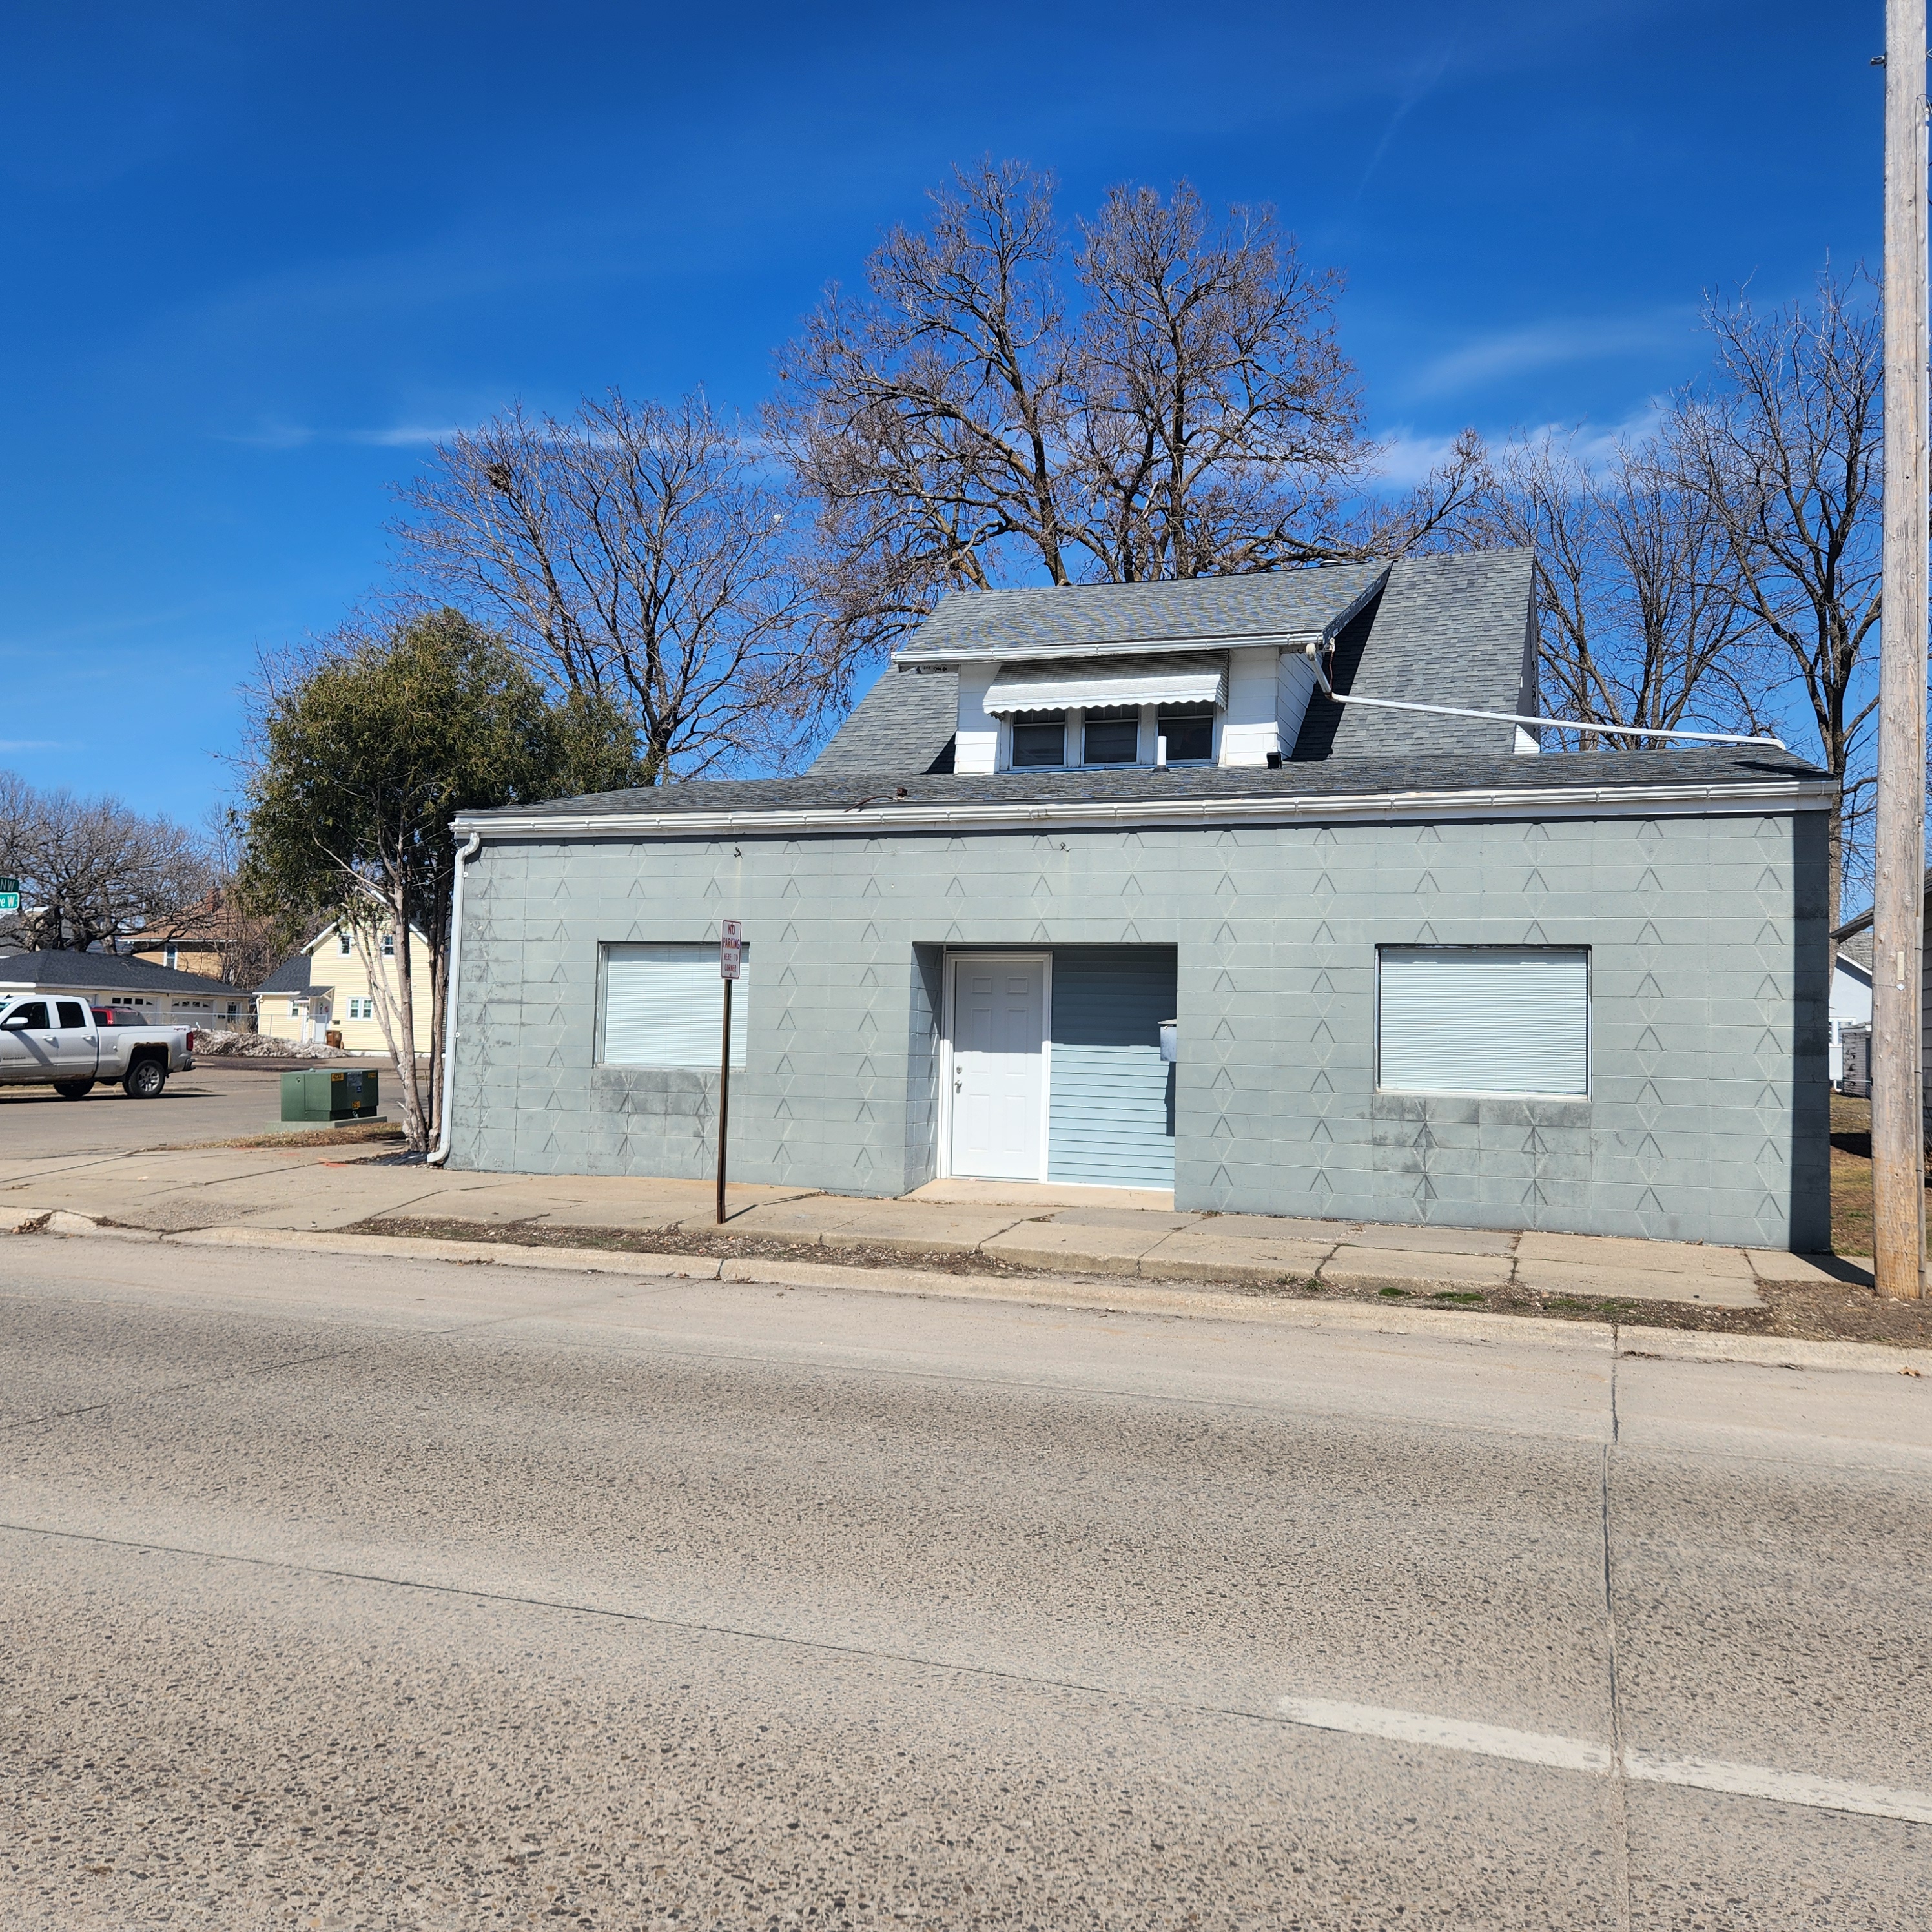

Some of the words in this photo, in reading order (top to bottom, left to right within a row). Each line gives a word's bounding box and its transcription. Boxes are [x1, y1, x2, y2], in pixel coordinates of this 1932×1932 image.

[728, 924, 735, 935] NO
[723, 937, 740, 949] PARKING
[724, 963, 737, 972] CORNER
